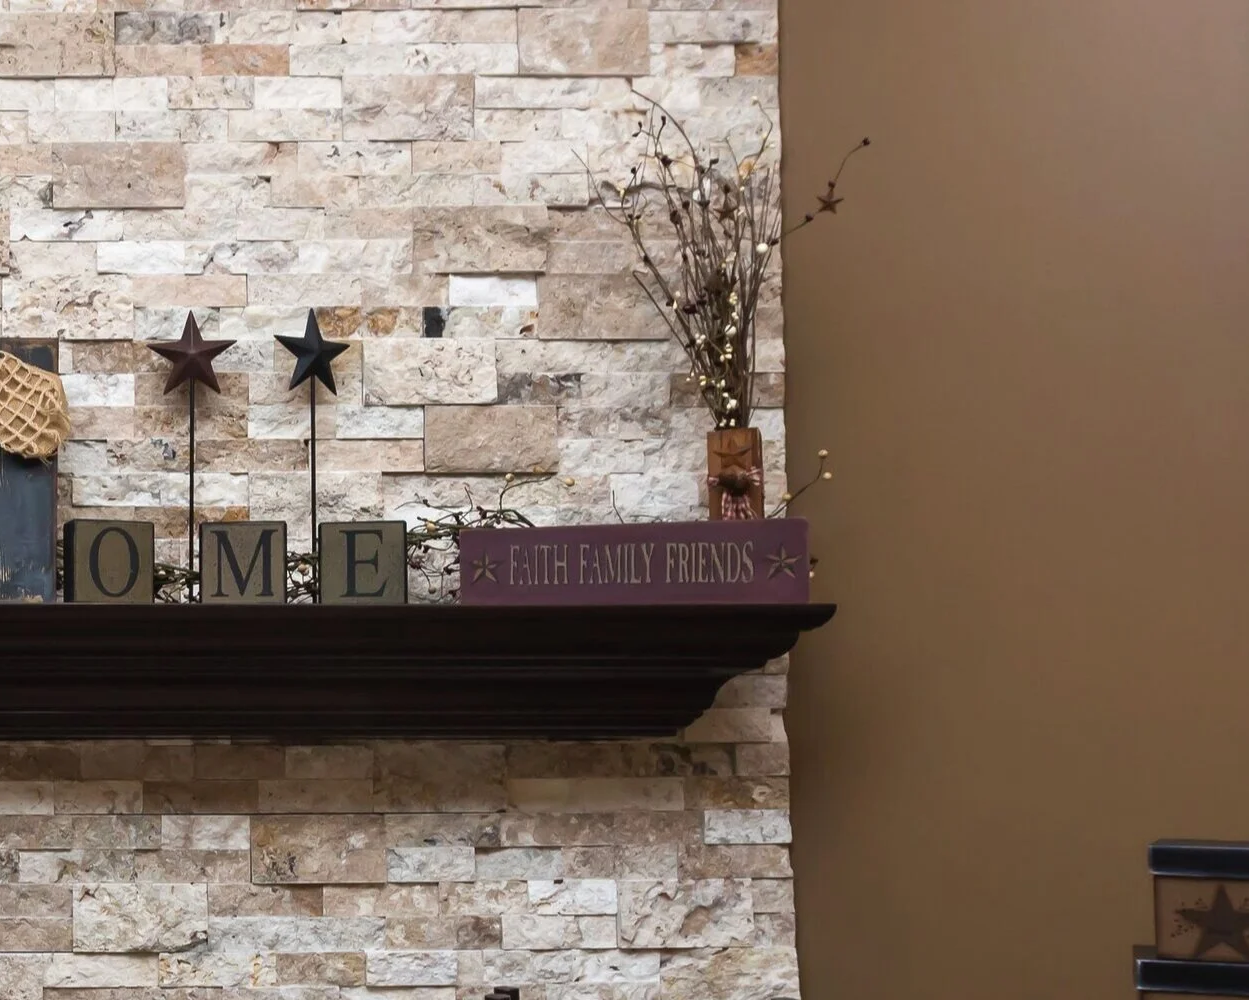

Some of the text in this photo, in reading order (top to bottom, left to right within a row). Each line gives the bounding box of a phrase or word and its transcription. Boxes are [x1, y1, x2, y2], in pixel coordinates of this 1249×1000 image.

[509, 540, 754, 585] FAITH FAMILY FRIENDS
